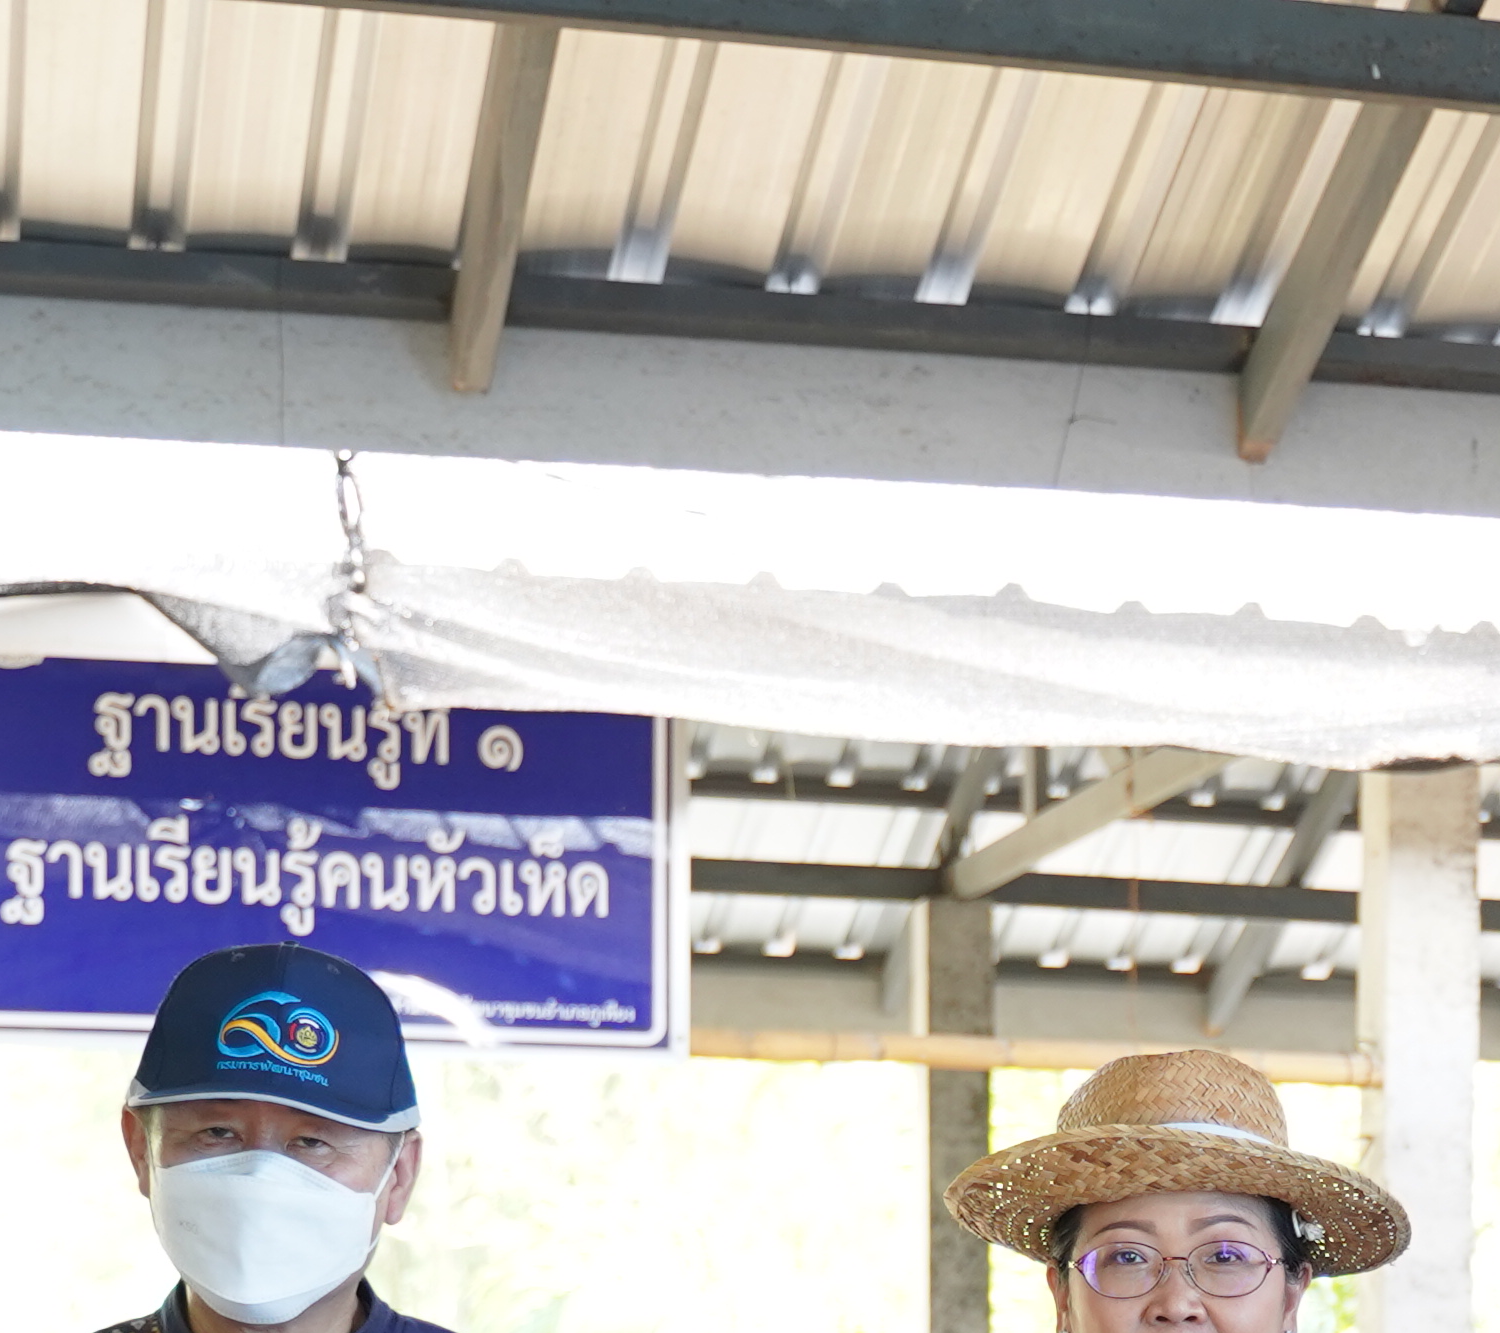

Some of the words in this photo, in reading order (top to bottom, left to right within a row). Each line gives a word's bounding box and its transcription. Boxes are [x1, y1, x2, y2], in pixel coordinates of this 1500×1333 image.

[88, 692, 450, 791] ฐานเรยนรูท
[477, 725, 525, 773] ๑
[0, 814, 610, 937] ฐานเรียนรู้คนหัวเห็ด
